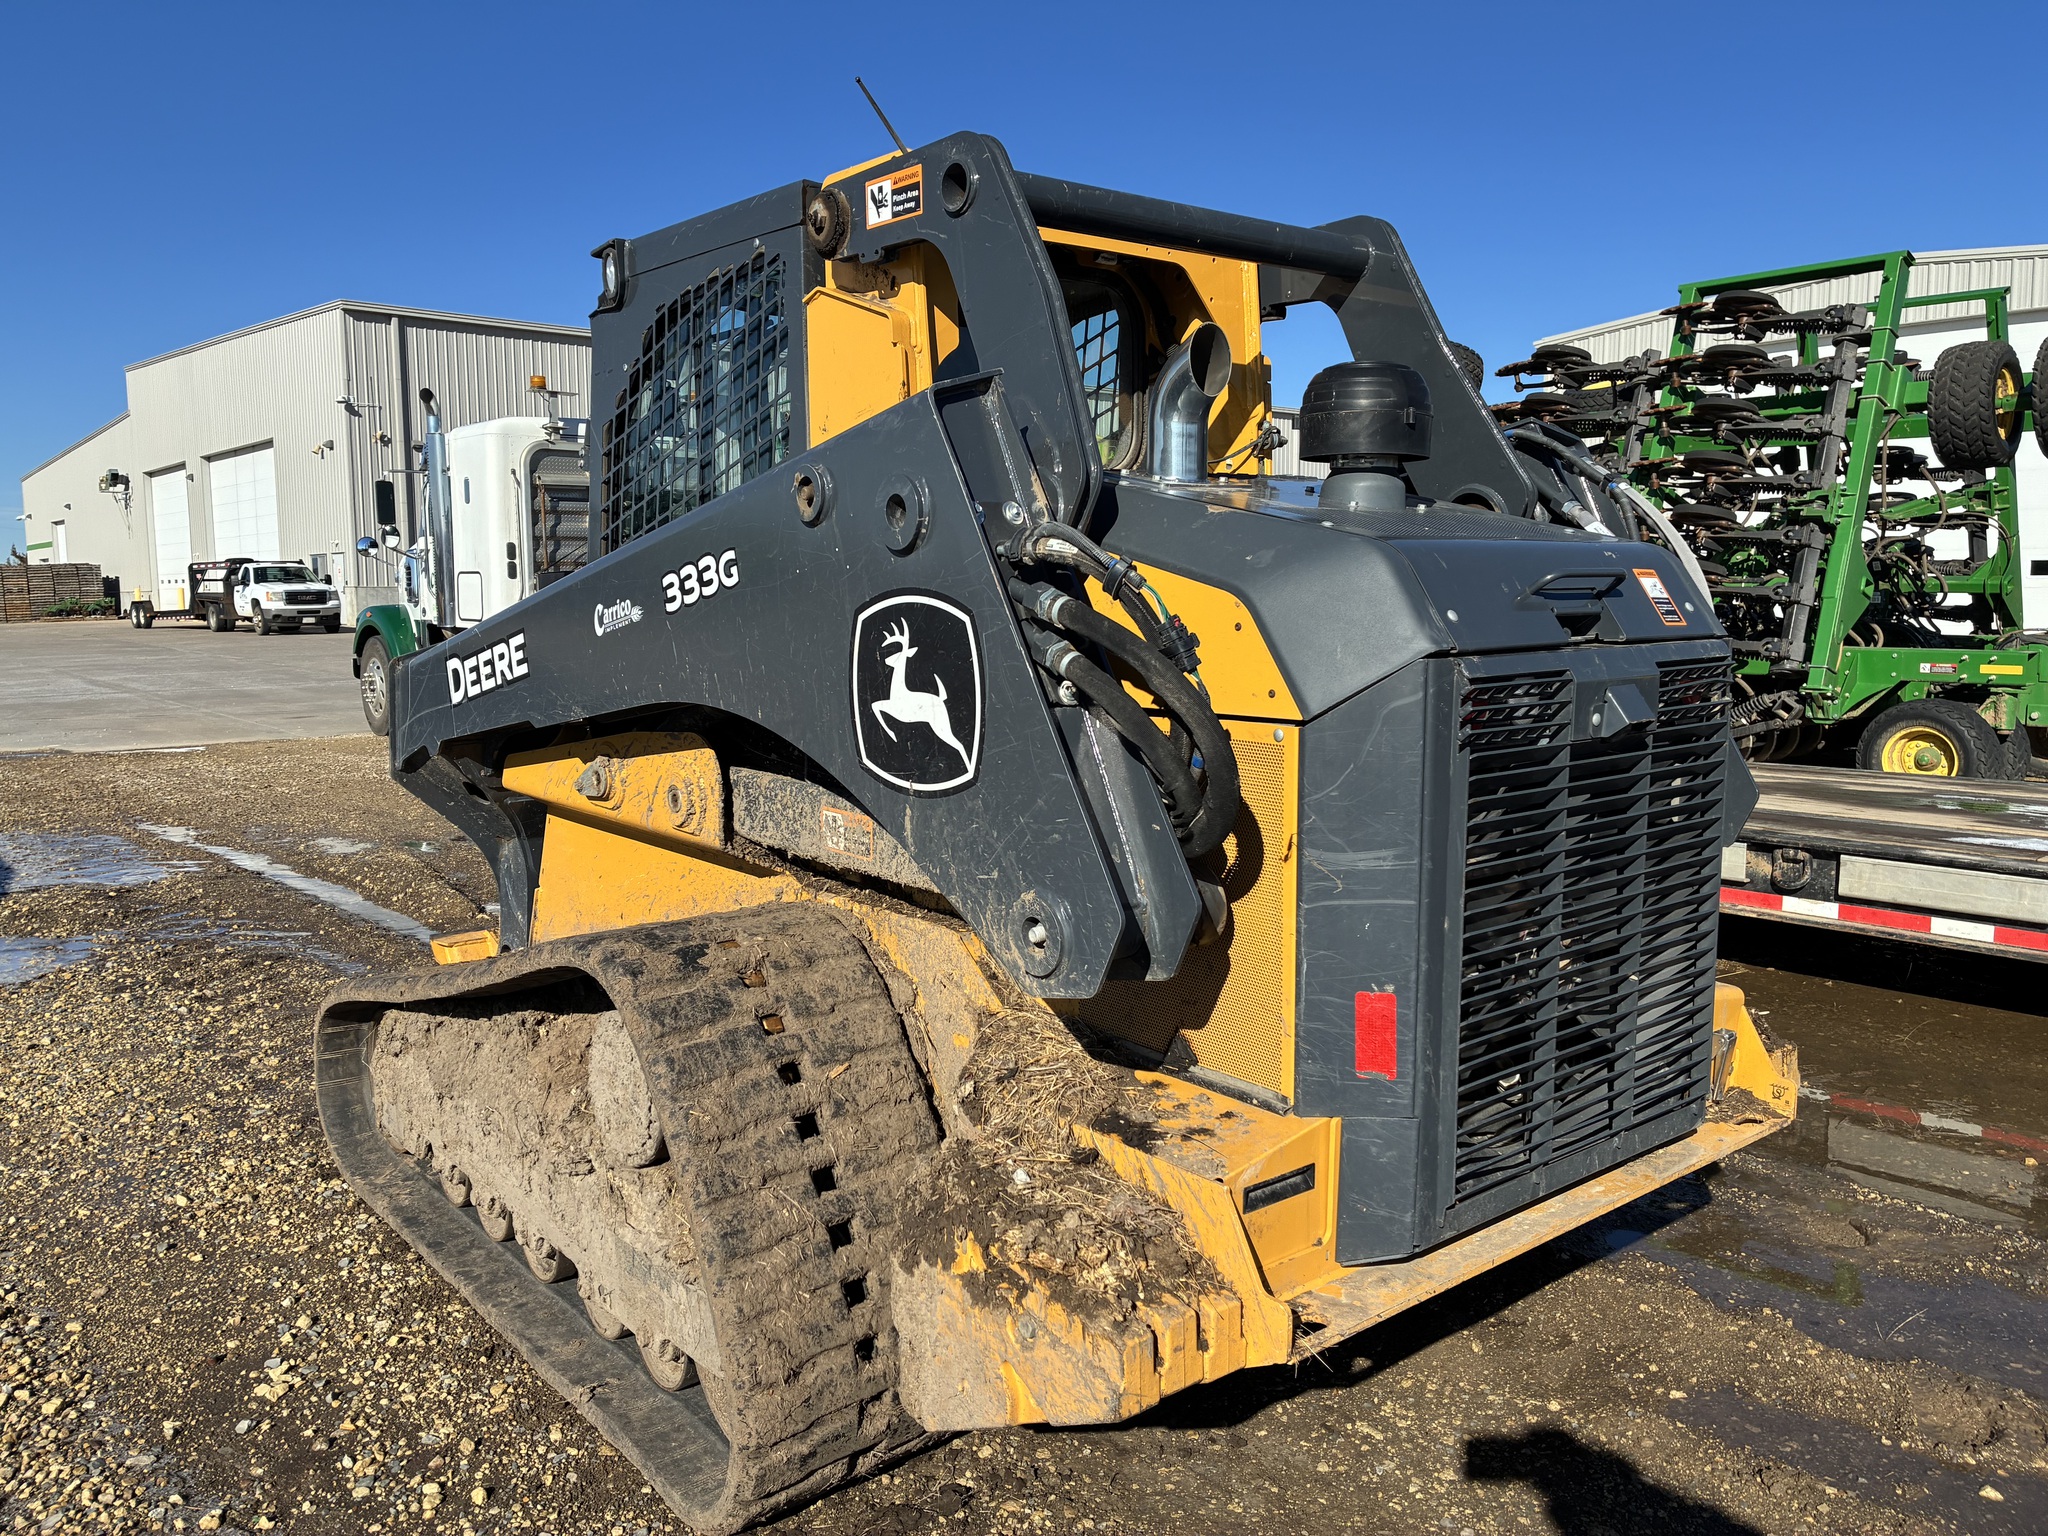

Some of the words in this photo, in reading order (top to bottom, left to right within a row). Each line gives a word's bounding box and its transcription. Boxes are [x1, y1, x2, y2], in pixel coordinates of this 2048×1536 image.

[897, 171, 920, 184] WARNING
[893, 192, 907, 203] Pinch
[907, 189, 919, 198] Area
[893, 204, 904, 212] Keep
[904, 201, 916, 209] Away
[662, 550, 739, 612] 333G
[594, 599, 632, 637] Carrico
[605, 619, 631, 633] IMPLEMENT
[446, 632, 529, 705] DEERE
